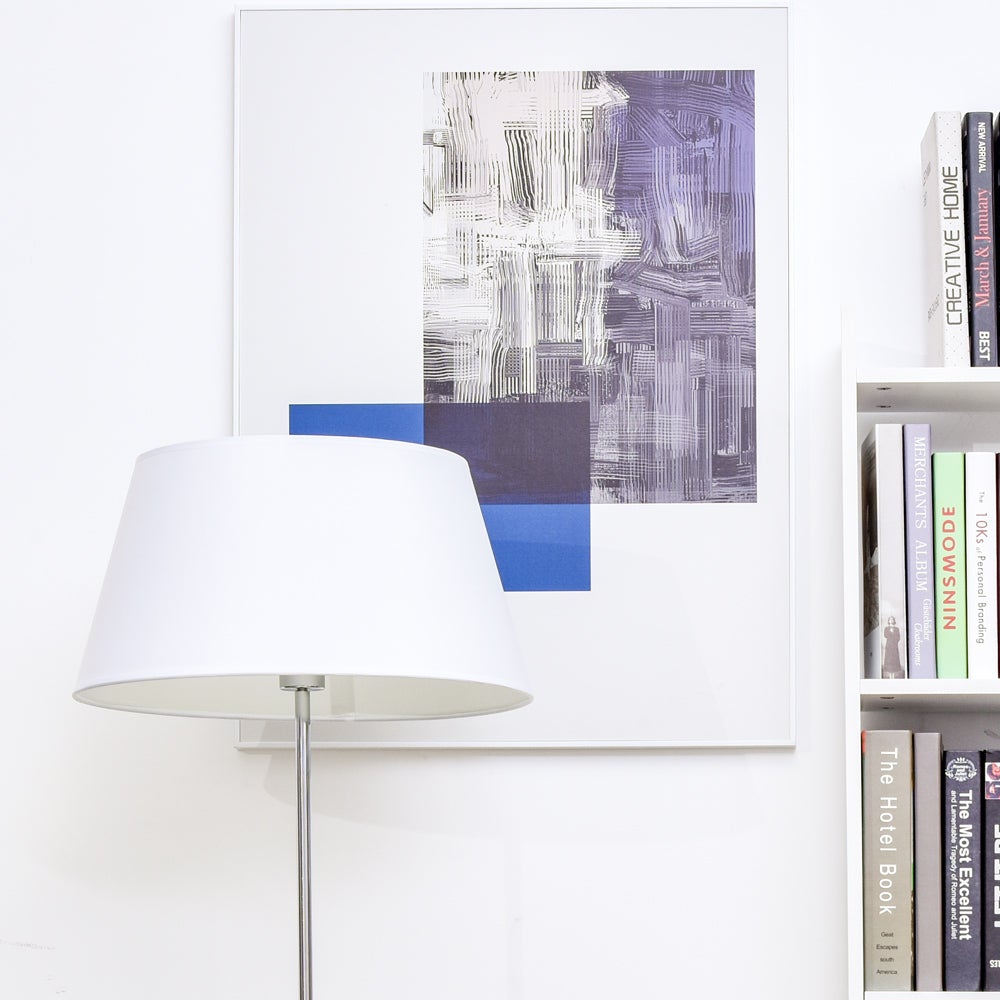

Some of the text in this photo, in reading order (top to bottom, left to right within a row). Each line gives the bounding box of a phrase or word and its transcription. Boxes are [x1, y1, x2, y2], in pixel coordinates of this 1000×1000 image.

[978, 122, 987, 173] NEW ARRIVAL
[942, 166, 963, 326] CREATIVE HOME
[974, 187, 991, 307] March & January
[978, 331, 990, 361] BEST
[913, 436, 928, 592] MERCHANTS ALBUM
[975, 512, 988, 544] 10Ks
[942, 507, 957, 630] NINSMODE
[977, 555, 986, 598] Personal
[913, 622, 923, 666] Cloakrooms
[976, 603, 986, 644] Branding
[950, 804, 958, 843] Lamentable
[959, 789, 973, 819] The
[879, 747, 898, 914] The Hotel Book
[959, 824, 973, 863] Most
[949, 845, 958, 873] Tragedy
[950, 882, 958, 906] Romeo
[950, 907, 958, 920] and
[959, 867, 973, 941] Excellent
[950, 921, 958, 940] Juliet
